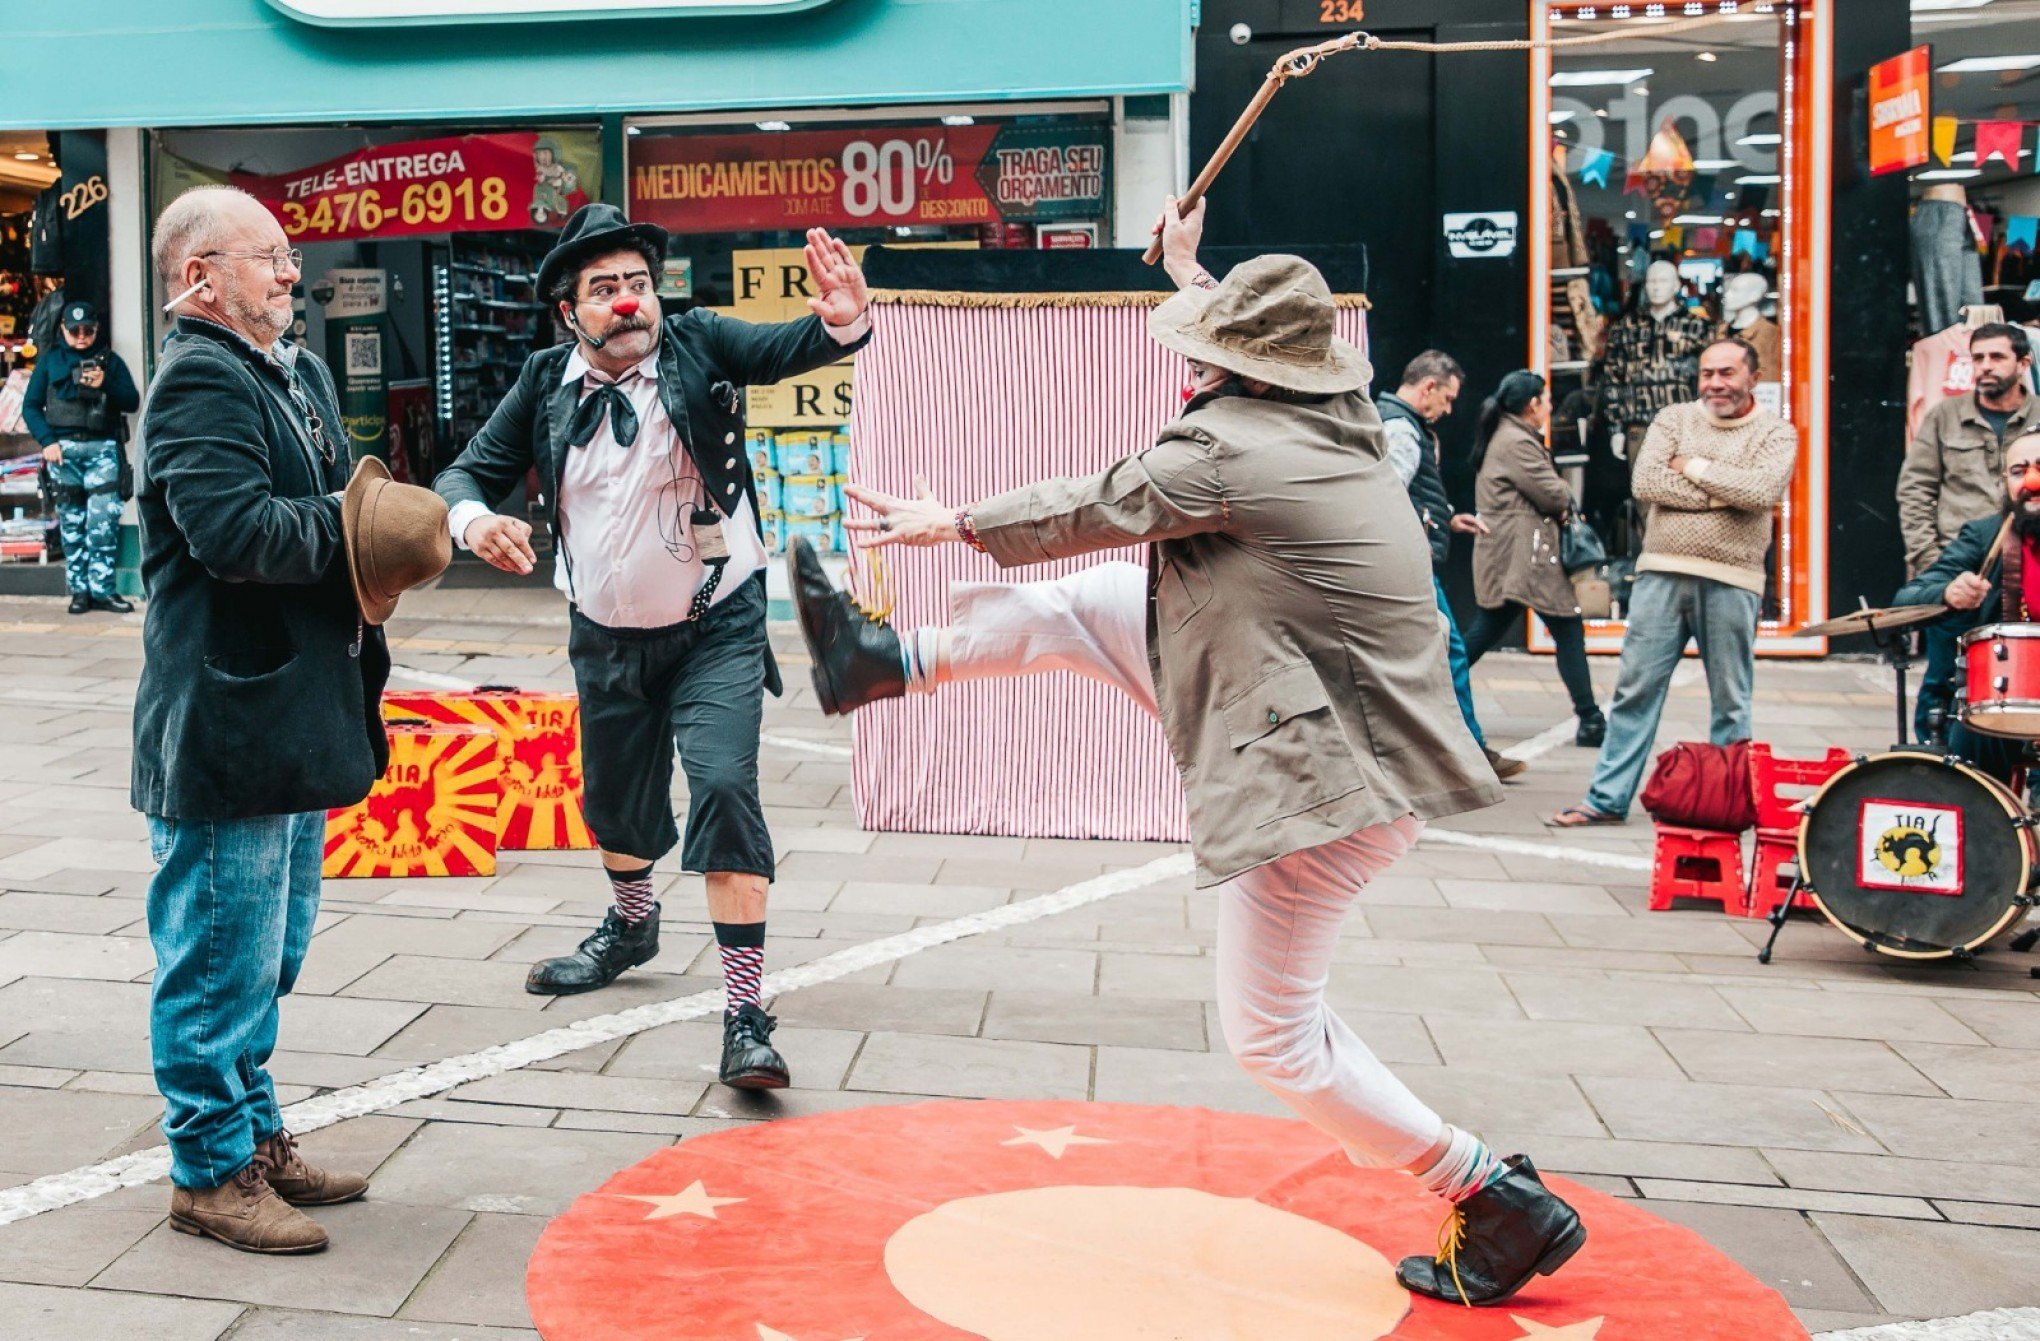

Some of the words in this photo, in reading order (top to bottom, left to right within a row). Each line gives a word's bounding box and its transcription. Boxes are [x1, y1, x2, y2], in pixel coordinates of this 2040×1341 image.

[1320, 0, 1364, 23] 234
[285, 150, 466, 198] TELE-ENTREGA
[842, 137, 953, 217] 80%
[999, 148, 1061, 177] TRAGA
[1064, 145, 1102, 174] SEU
[636, 158, 836, 200] MEDICAMENTOS
[999, 174, 1100, 206] ORÇAMENTO
[60, 175, 107, 220] 226
[282, 177, 509, 236] 3476-6918
[920, 198, 988, 218] DESCONTO
[792, 381, 853, 418] R$
[526, 710, 563, 728] TIA
[1895, 814, 1925, 830] TIA
